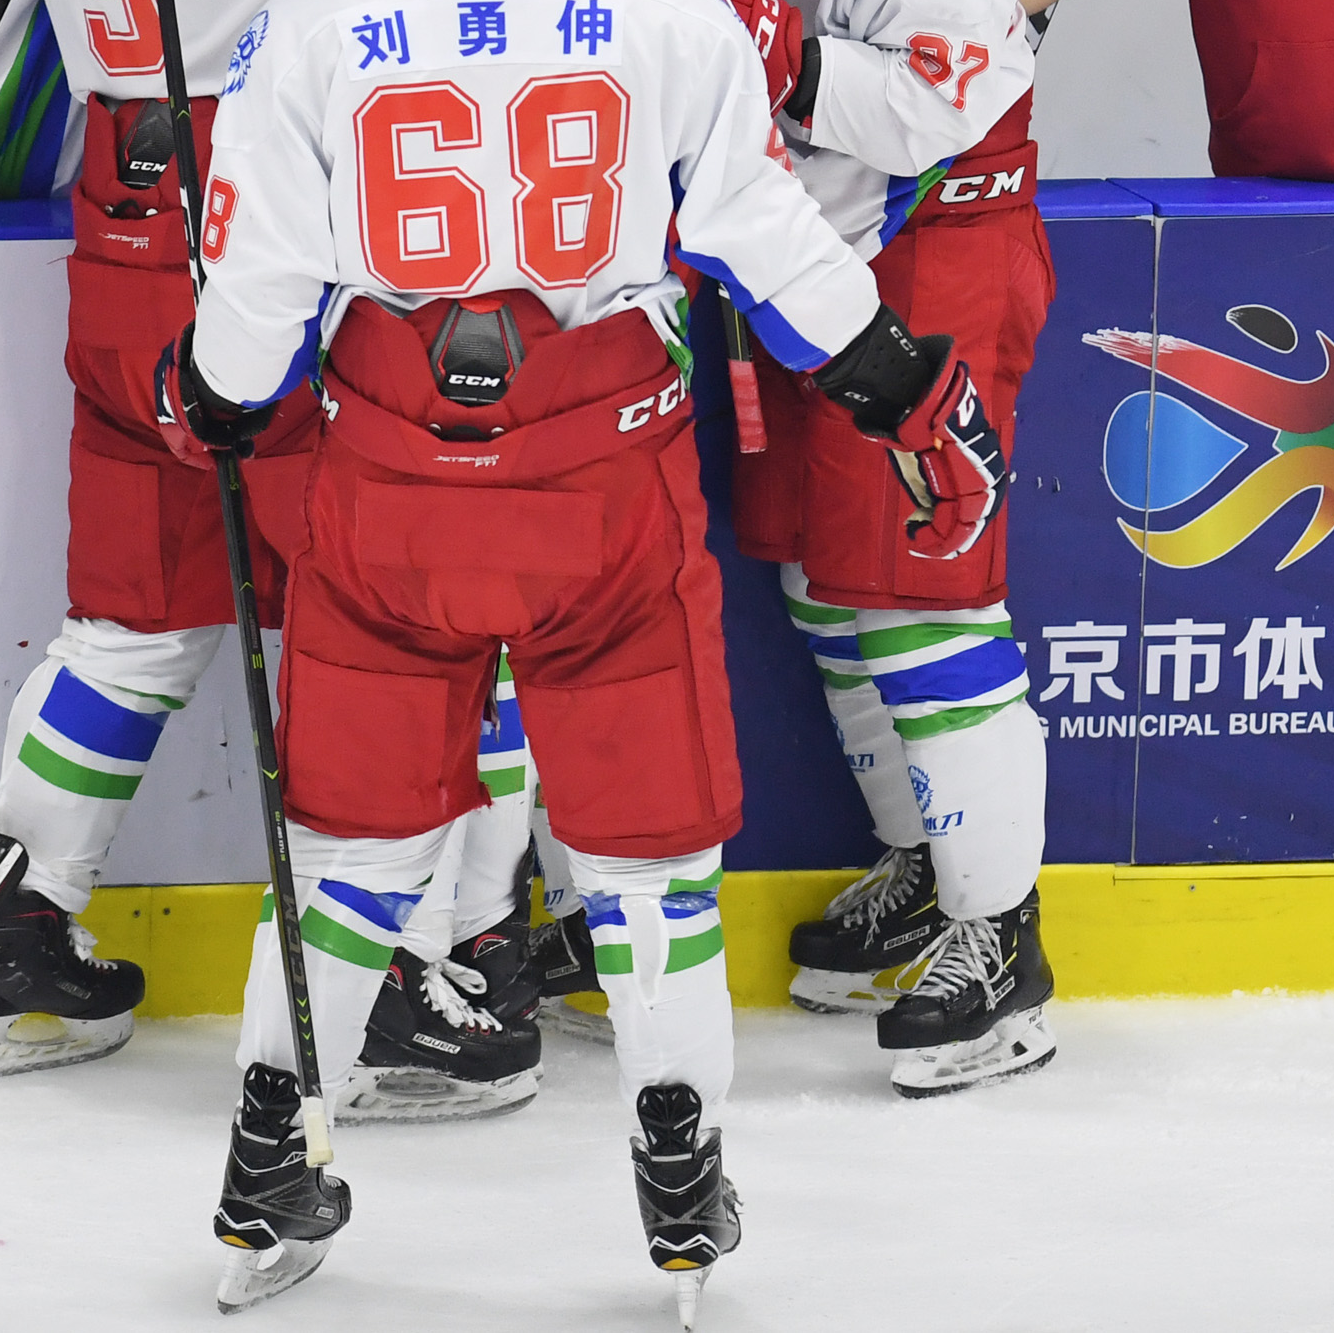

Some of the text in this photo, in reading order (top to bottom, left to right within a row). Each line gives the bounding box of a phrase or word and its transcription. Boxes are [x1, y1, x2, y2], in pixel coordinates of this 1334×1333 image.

[129, 159, 168, 173] CCM
[352, 70, 632, 296] 68
[938, 166, 1026, 204] CM
[448, 373, 501, 388] CCM
[1059, 711, 1220, 738] MUNICIPAL
[282, 893, 306, 986] CCM
